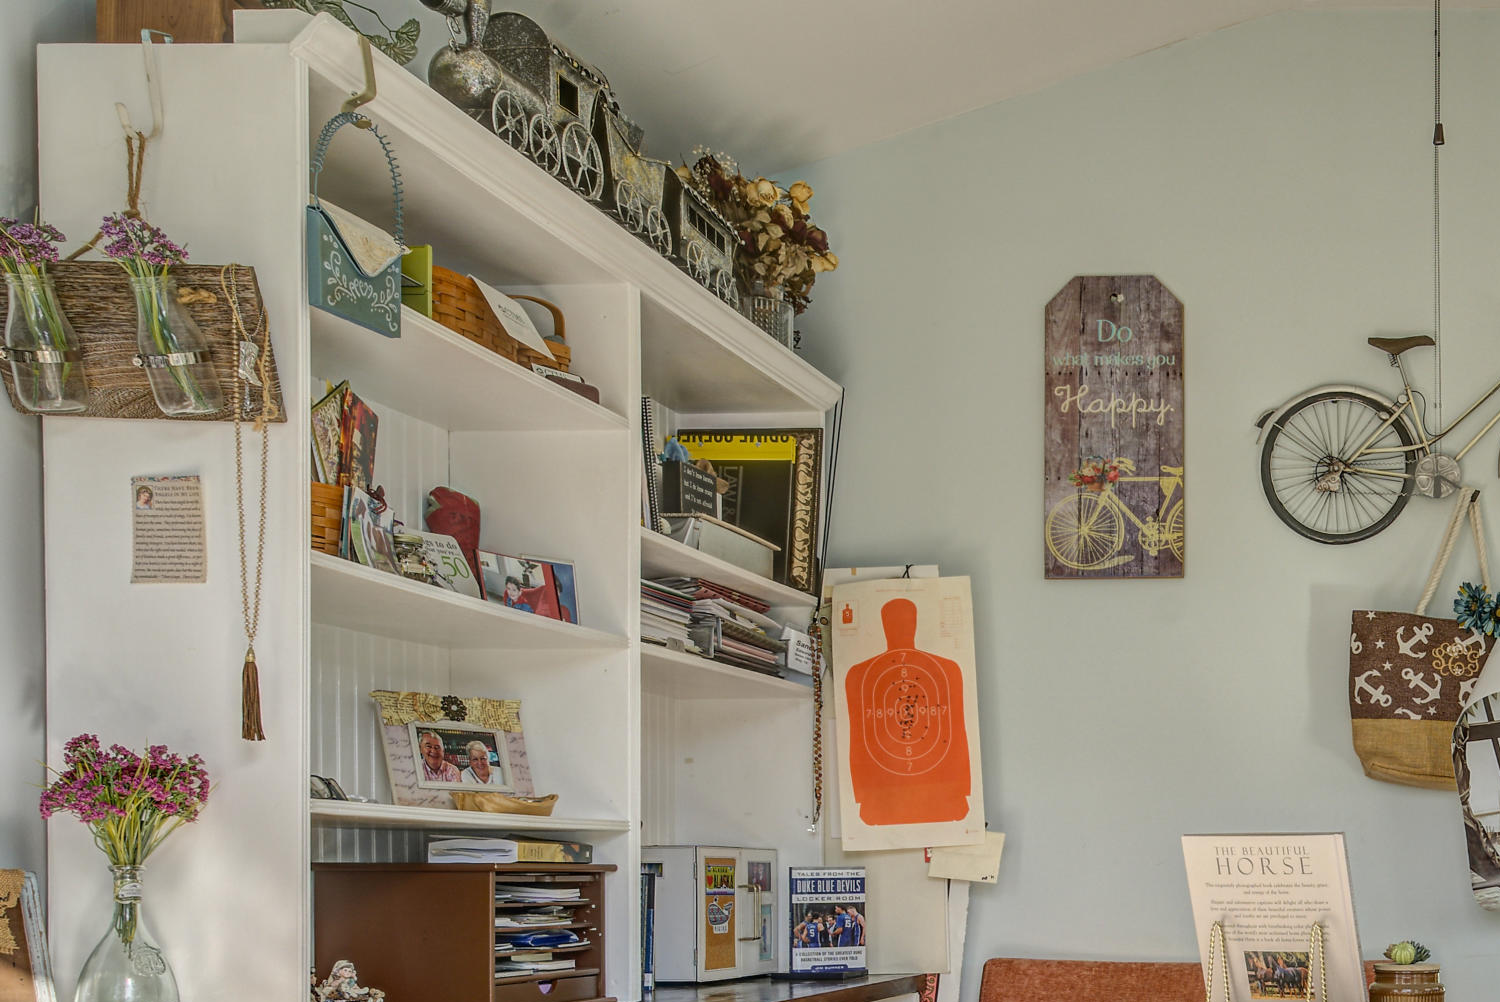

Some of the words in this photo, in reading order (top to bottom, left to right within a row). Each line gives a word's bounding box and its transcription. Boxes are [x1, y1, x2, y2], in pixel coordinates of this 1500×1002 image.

[1096, 319, 1133, 343] Do
[1052, 352, 1088, 367] what
[1093, 351, 1144, 367] makes
[1146, 356, 1176, 369] you
[1054, 384, 1175, 428] Happy.
[441, 554, 470, 579] 50
[901, 652, 907, 662] 7
[900, 668, 908, 678] 8
[866, 709, 873, 719] 7
[876, 708, 883, 718] 8
[905, 746, 913, 756] 8
[1213, 846, 1236, 856] THE
[1241, 845, 1310, 856] BEAUTIFUL
[1215, 856, 1313, 876] HORSE
[797, 880, 815, 893] DUKE
[817, 880, 835, 893] BLUE
[836, 879, 861, 892] DEVILS
